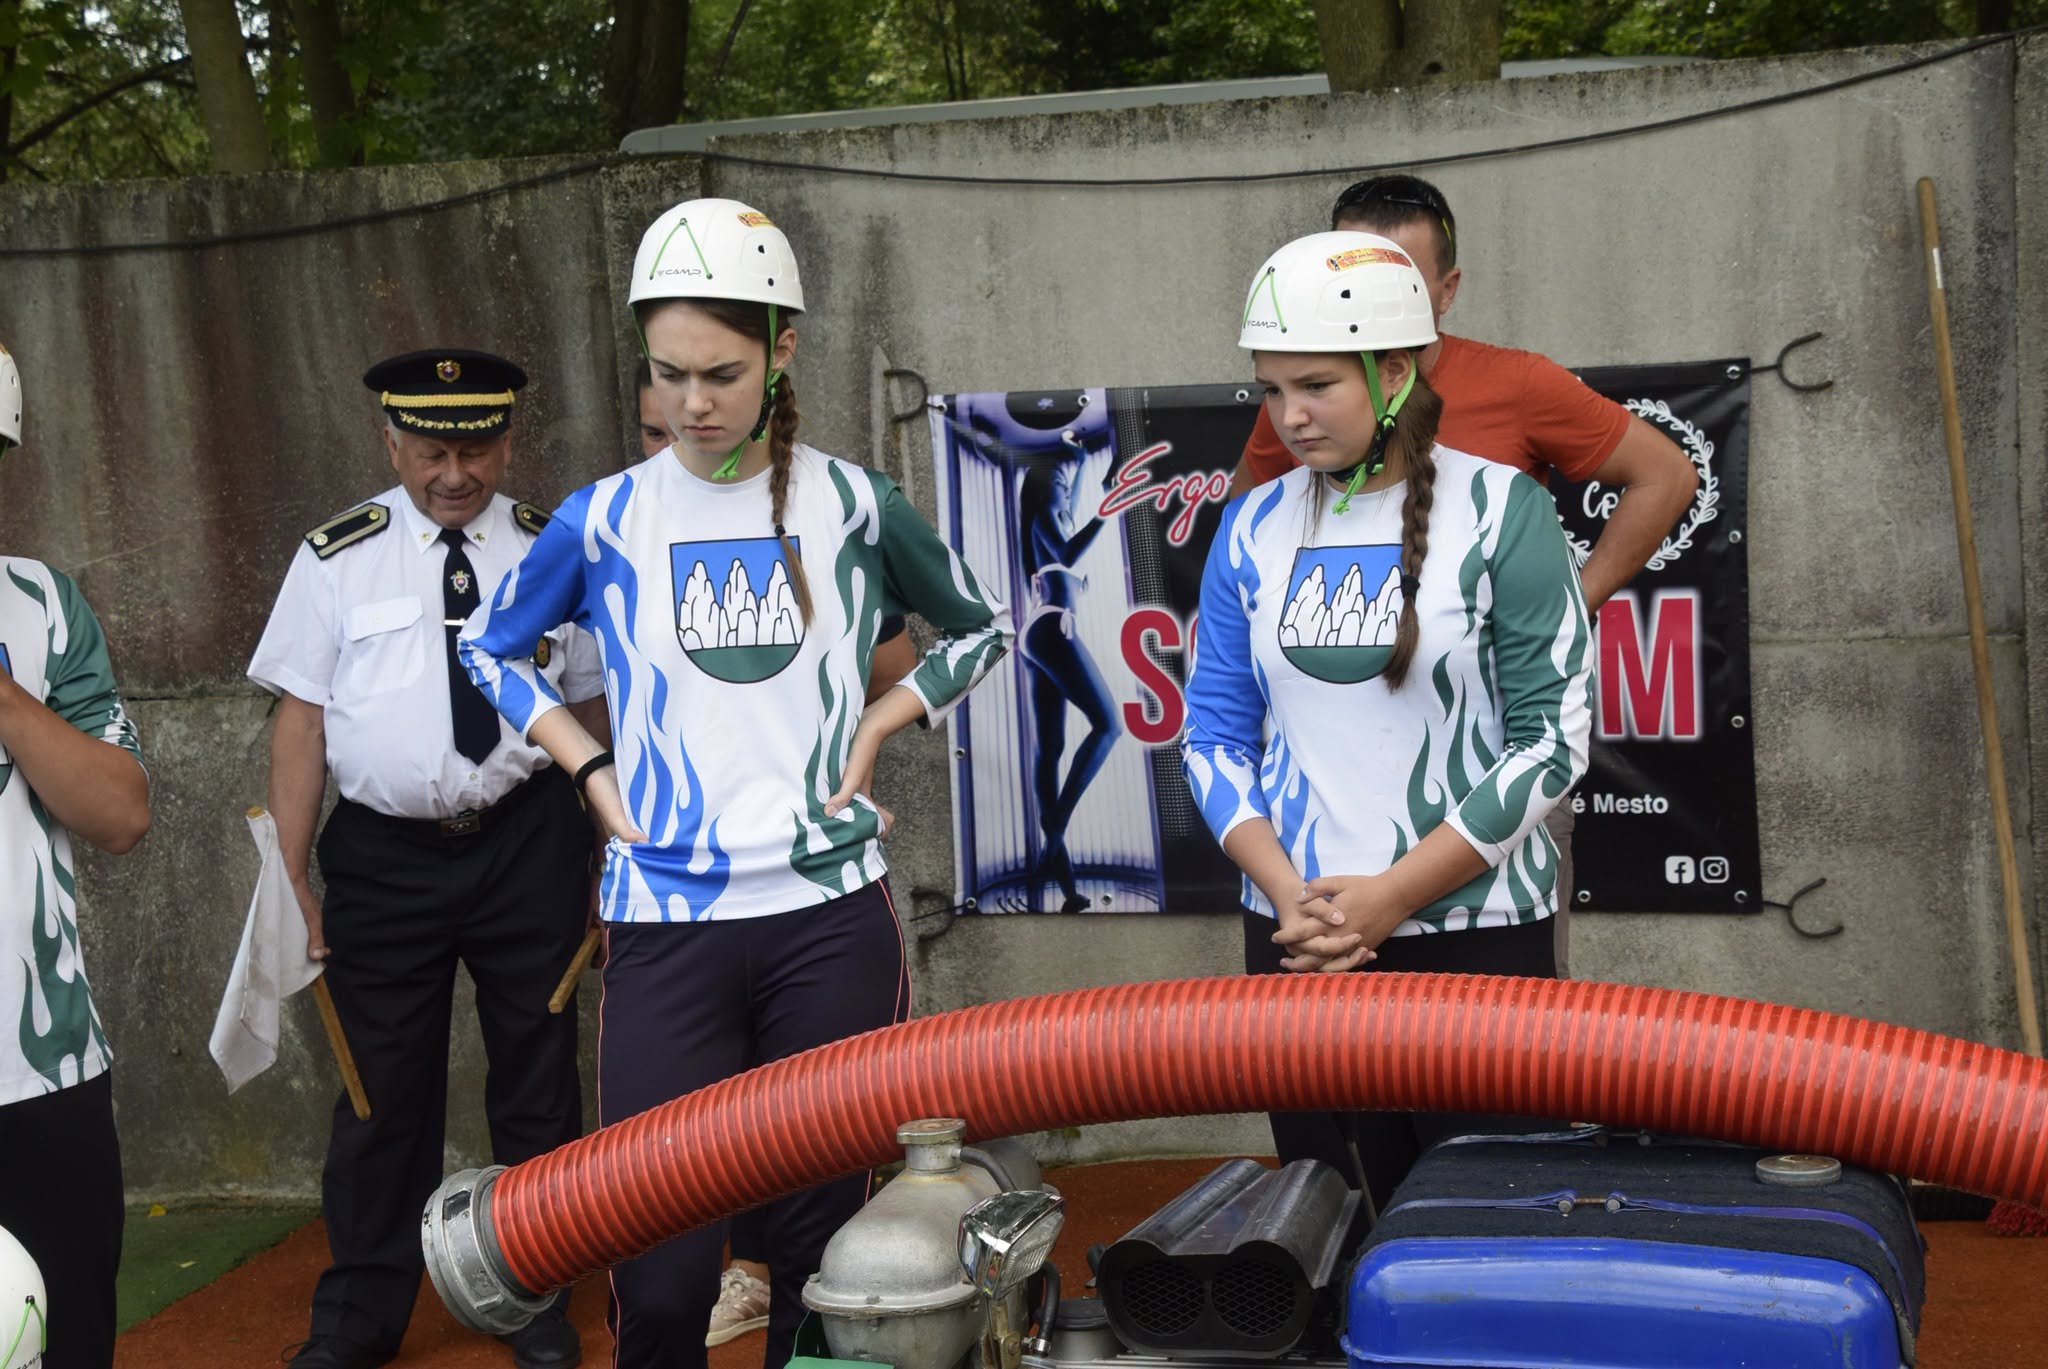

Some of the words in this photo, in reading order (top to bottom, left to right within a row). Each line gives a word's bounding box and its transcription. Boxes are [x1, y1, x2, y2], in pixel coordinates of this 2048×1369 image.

[665, 268, 702, 276] CAMP
[1098, 443, 1235, 544] Ergo
[1568, 792, 1586, 814] é
[1593, 793, 1669, 814] Mesto
